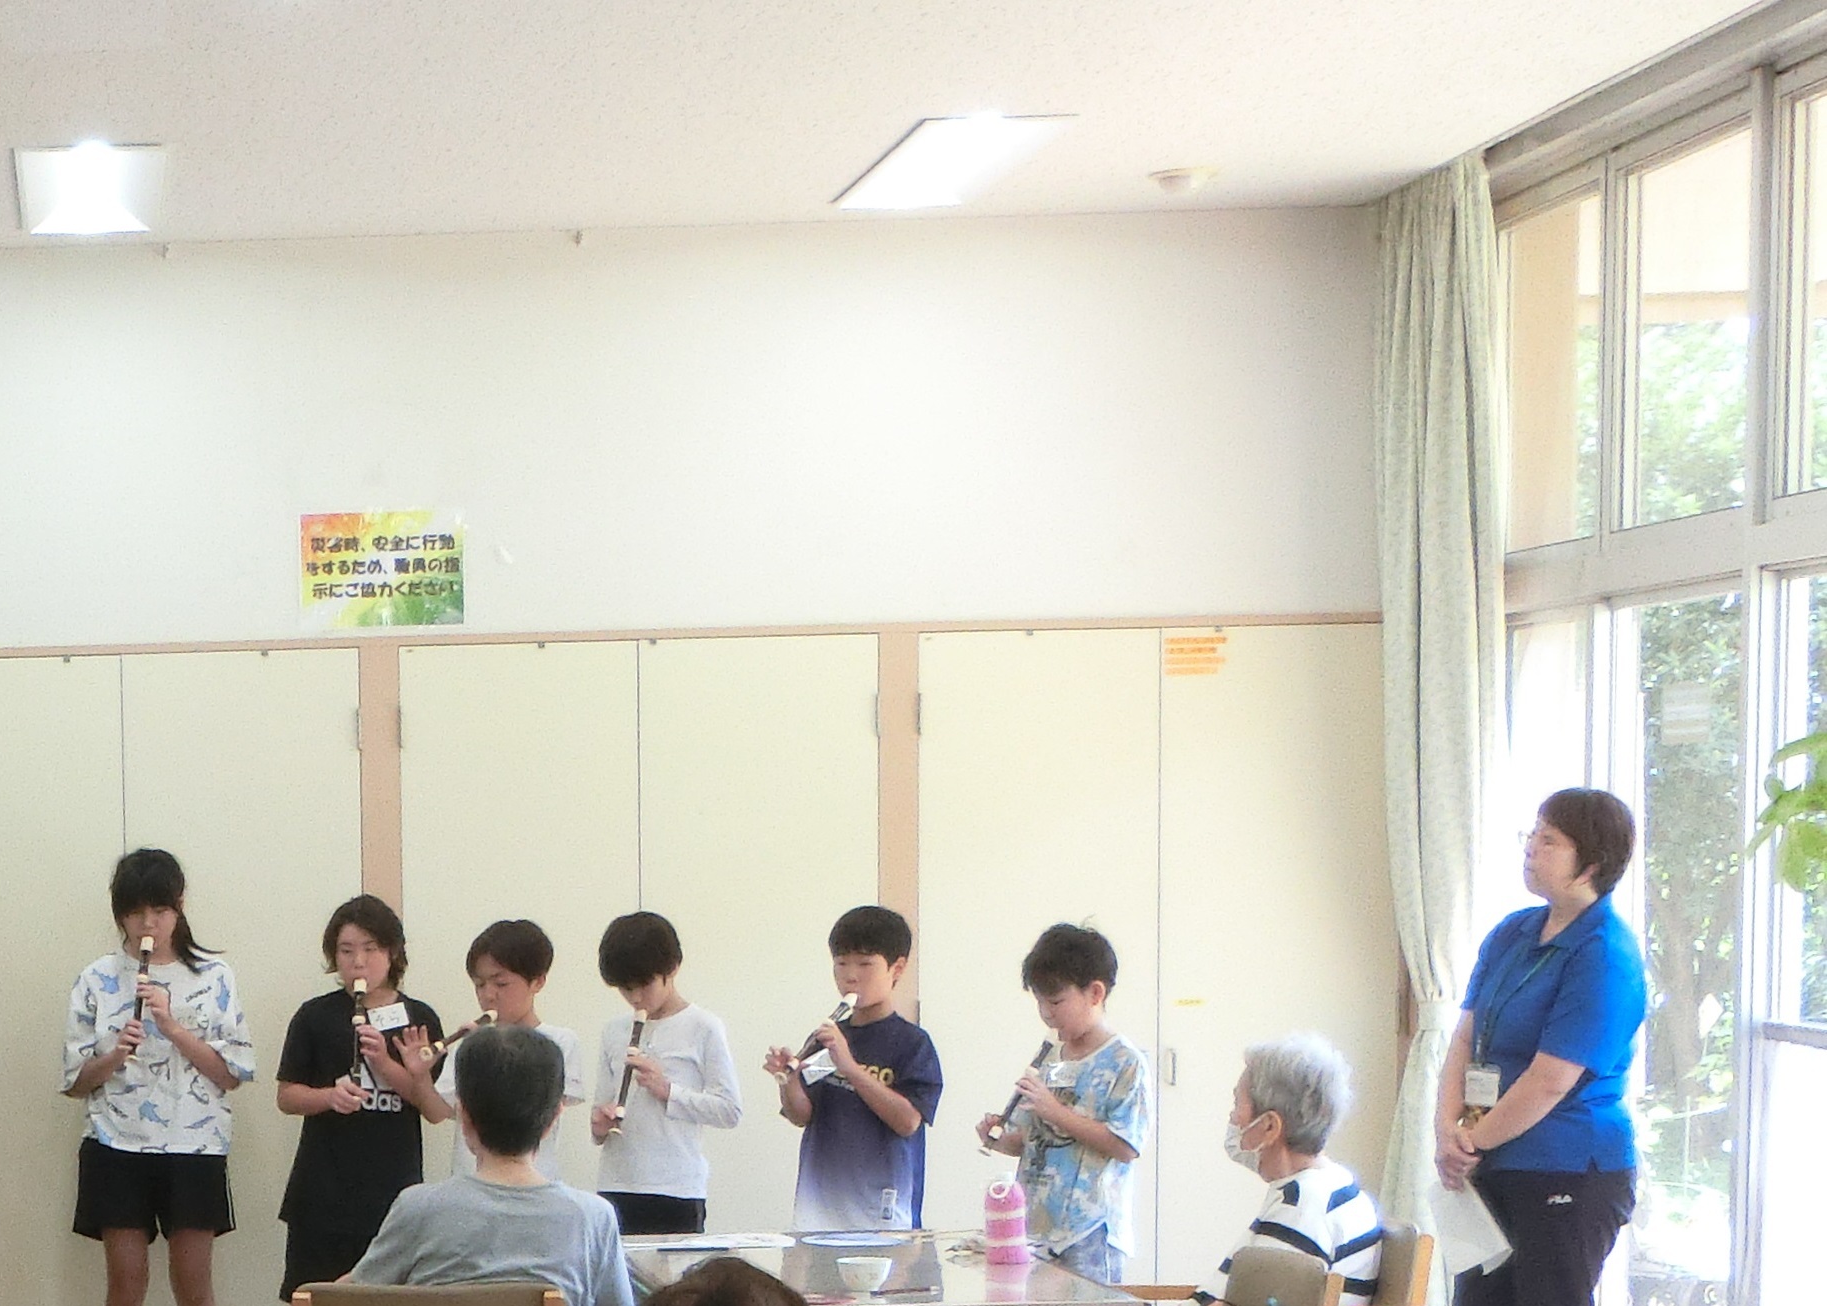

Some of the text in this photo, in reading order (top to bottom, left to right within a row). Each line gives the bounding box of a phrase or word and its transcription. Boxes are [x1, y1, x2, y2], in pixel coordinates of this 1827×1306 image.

[310, 533, 455, 553] 災害時、安全に行動
[306, 557, 461, 576] をするため、職員の指
[312, 579, 454, 599] 示にご協力ください
